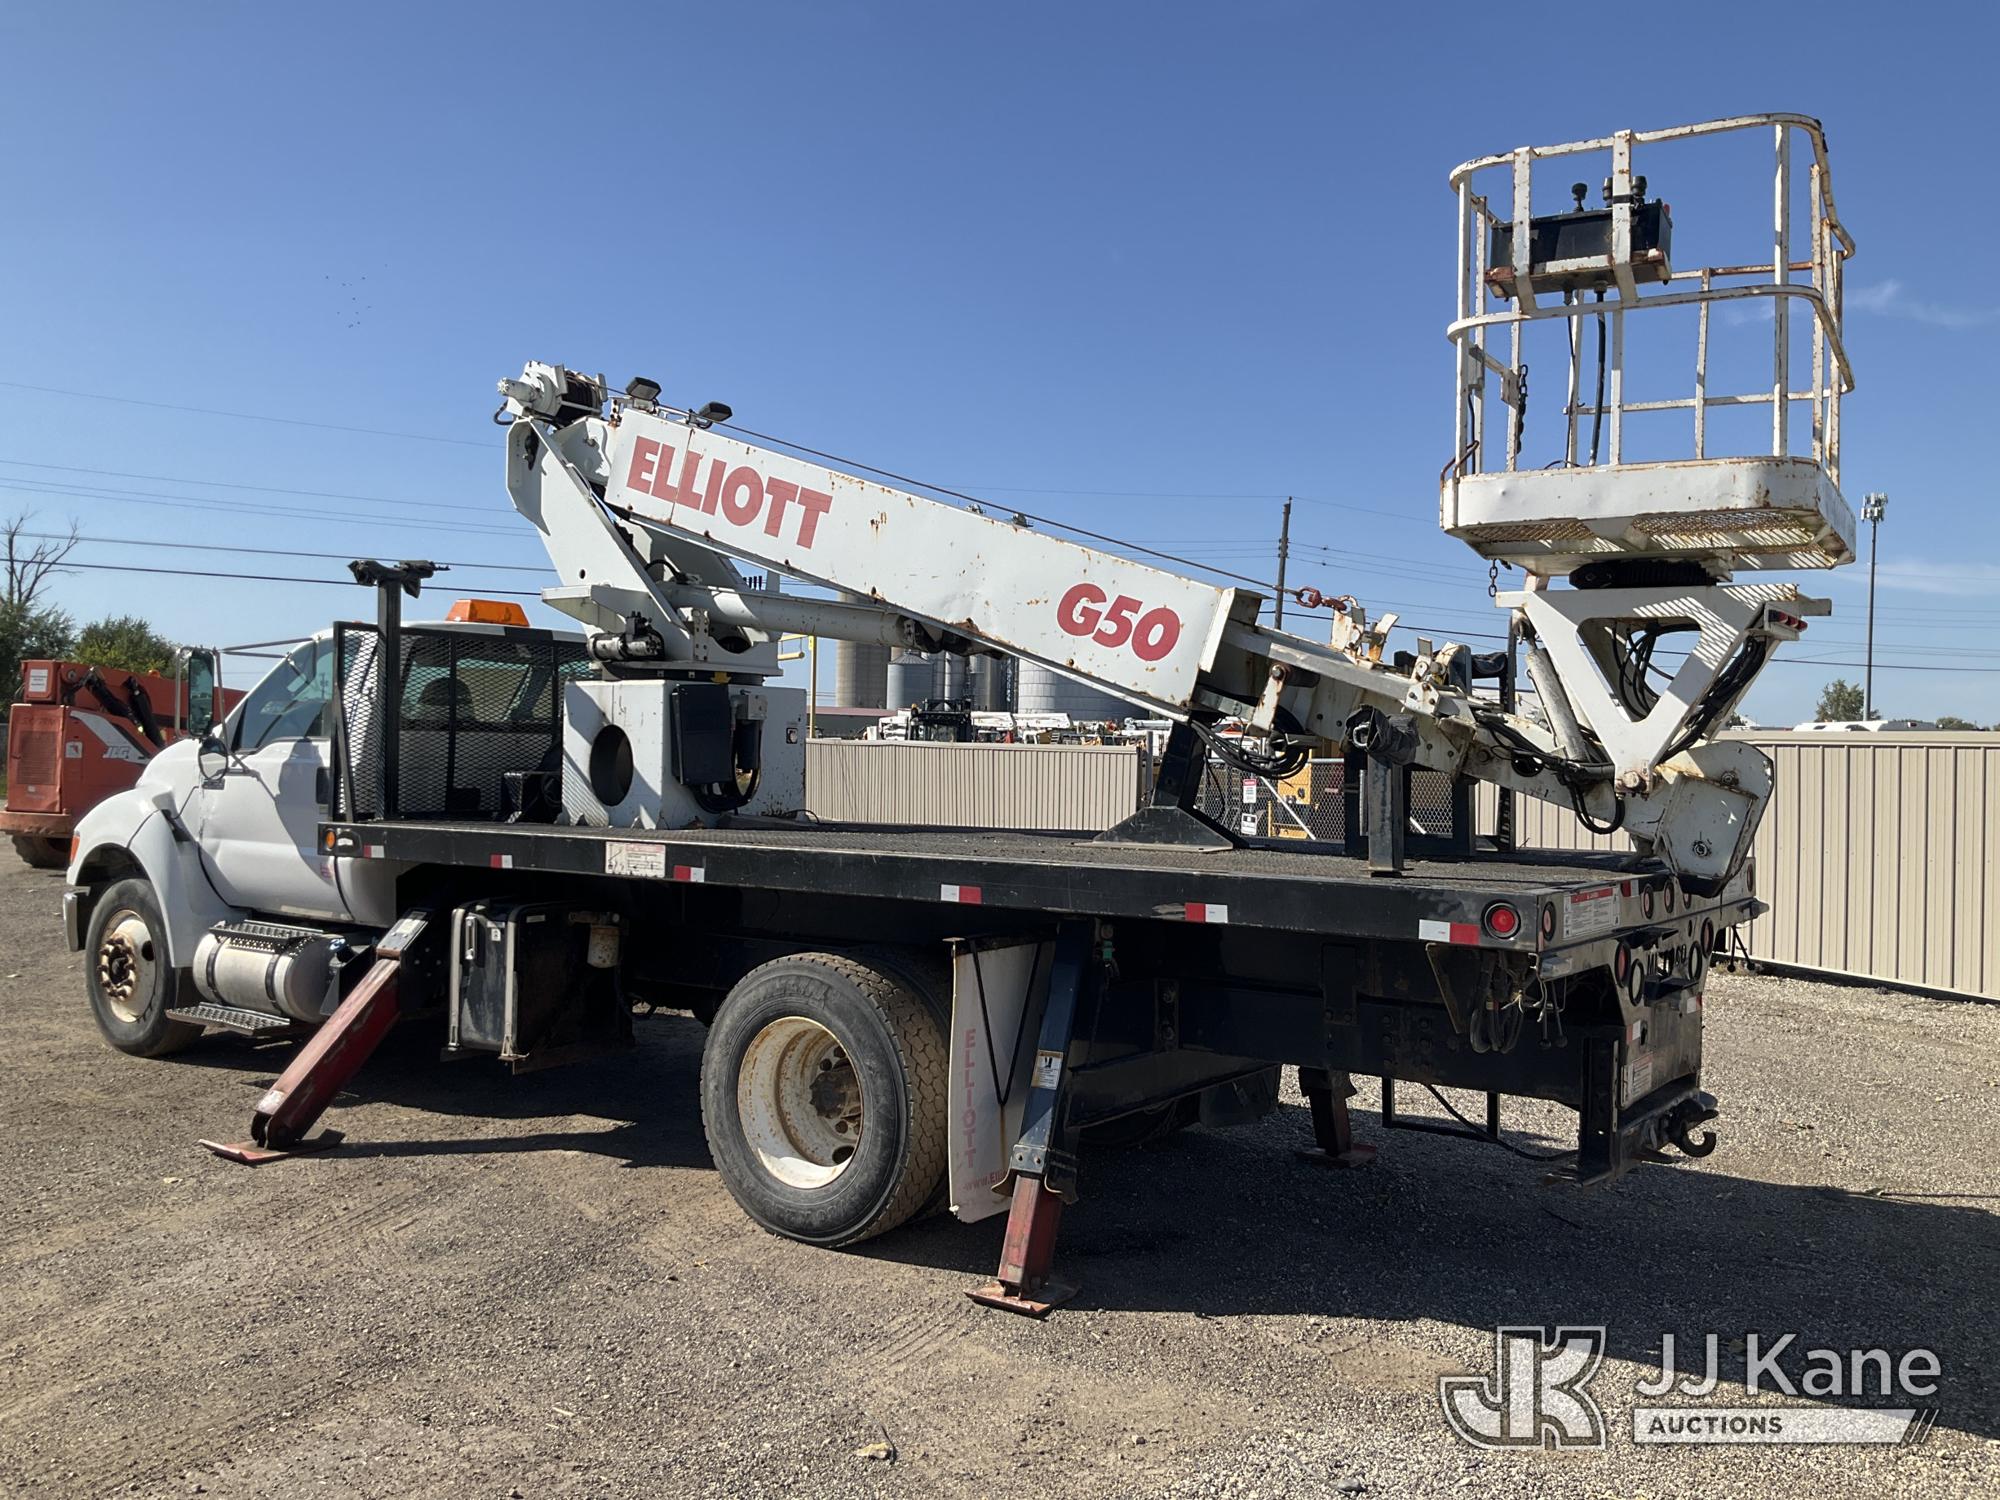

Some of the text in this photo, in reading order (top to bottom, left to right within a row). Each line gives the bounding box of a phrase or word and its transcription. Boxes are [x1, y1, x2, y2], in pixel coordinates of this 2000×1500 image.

[626, 435, 833, 549] ELLIOTT
[1057, 583, 1180, 661] G50
[963, 1029, 976, 1168] ELLIOTT
